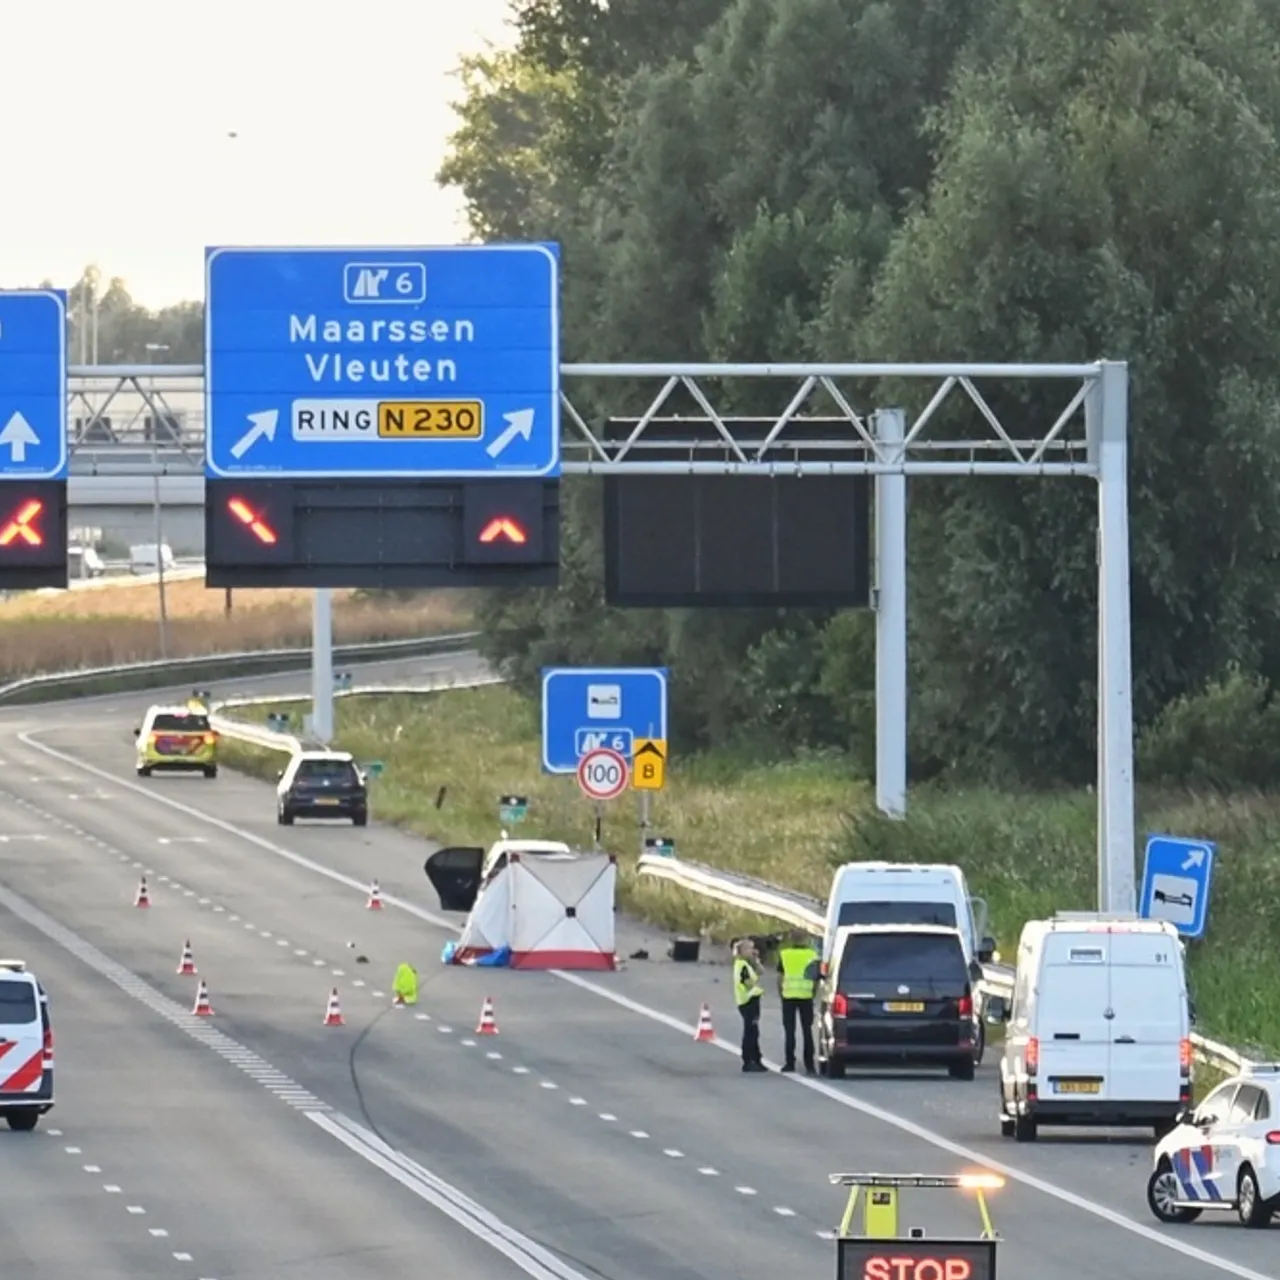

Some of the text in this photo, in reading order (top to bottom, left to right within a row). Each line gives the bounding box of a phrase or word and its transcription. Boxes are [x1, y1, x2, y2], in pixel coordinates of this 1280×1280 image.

[395, 272, 413, 294] 6
[289, 313, 474, 343] Maarssen
[304, 352, 457, 382] Vleuten
[297, 409, 371, 432] RING
[611, 735, 624, 751] 6
[587, 764, 620, 785] 100
